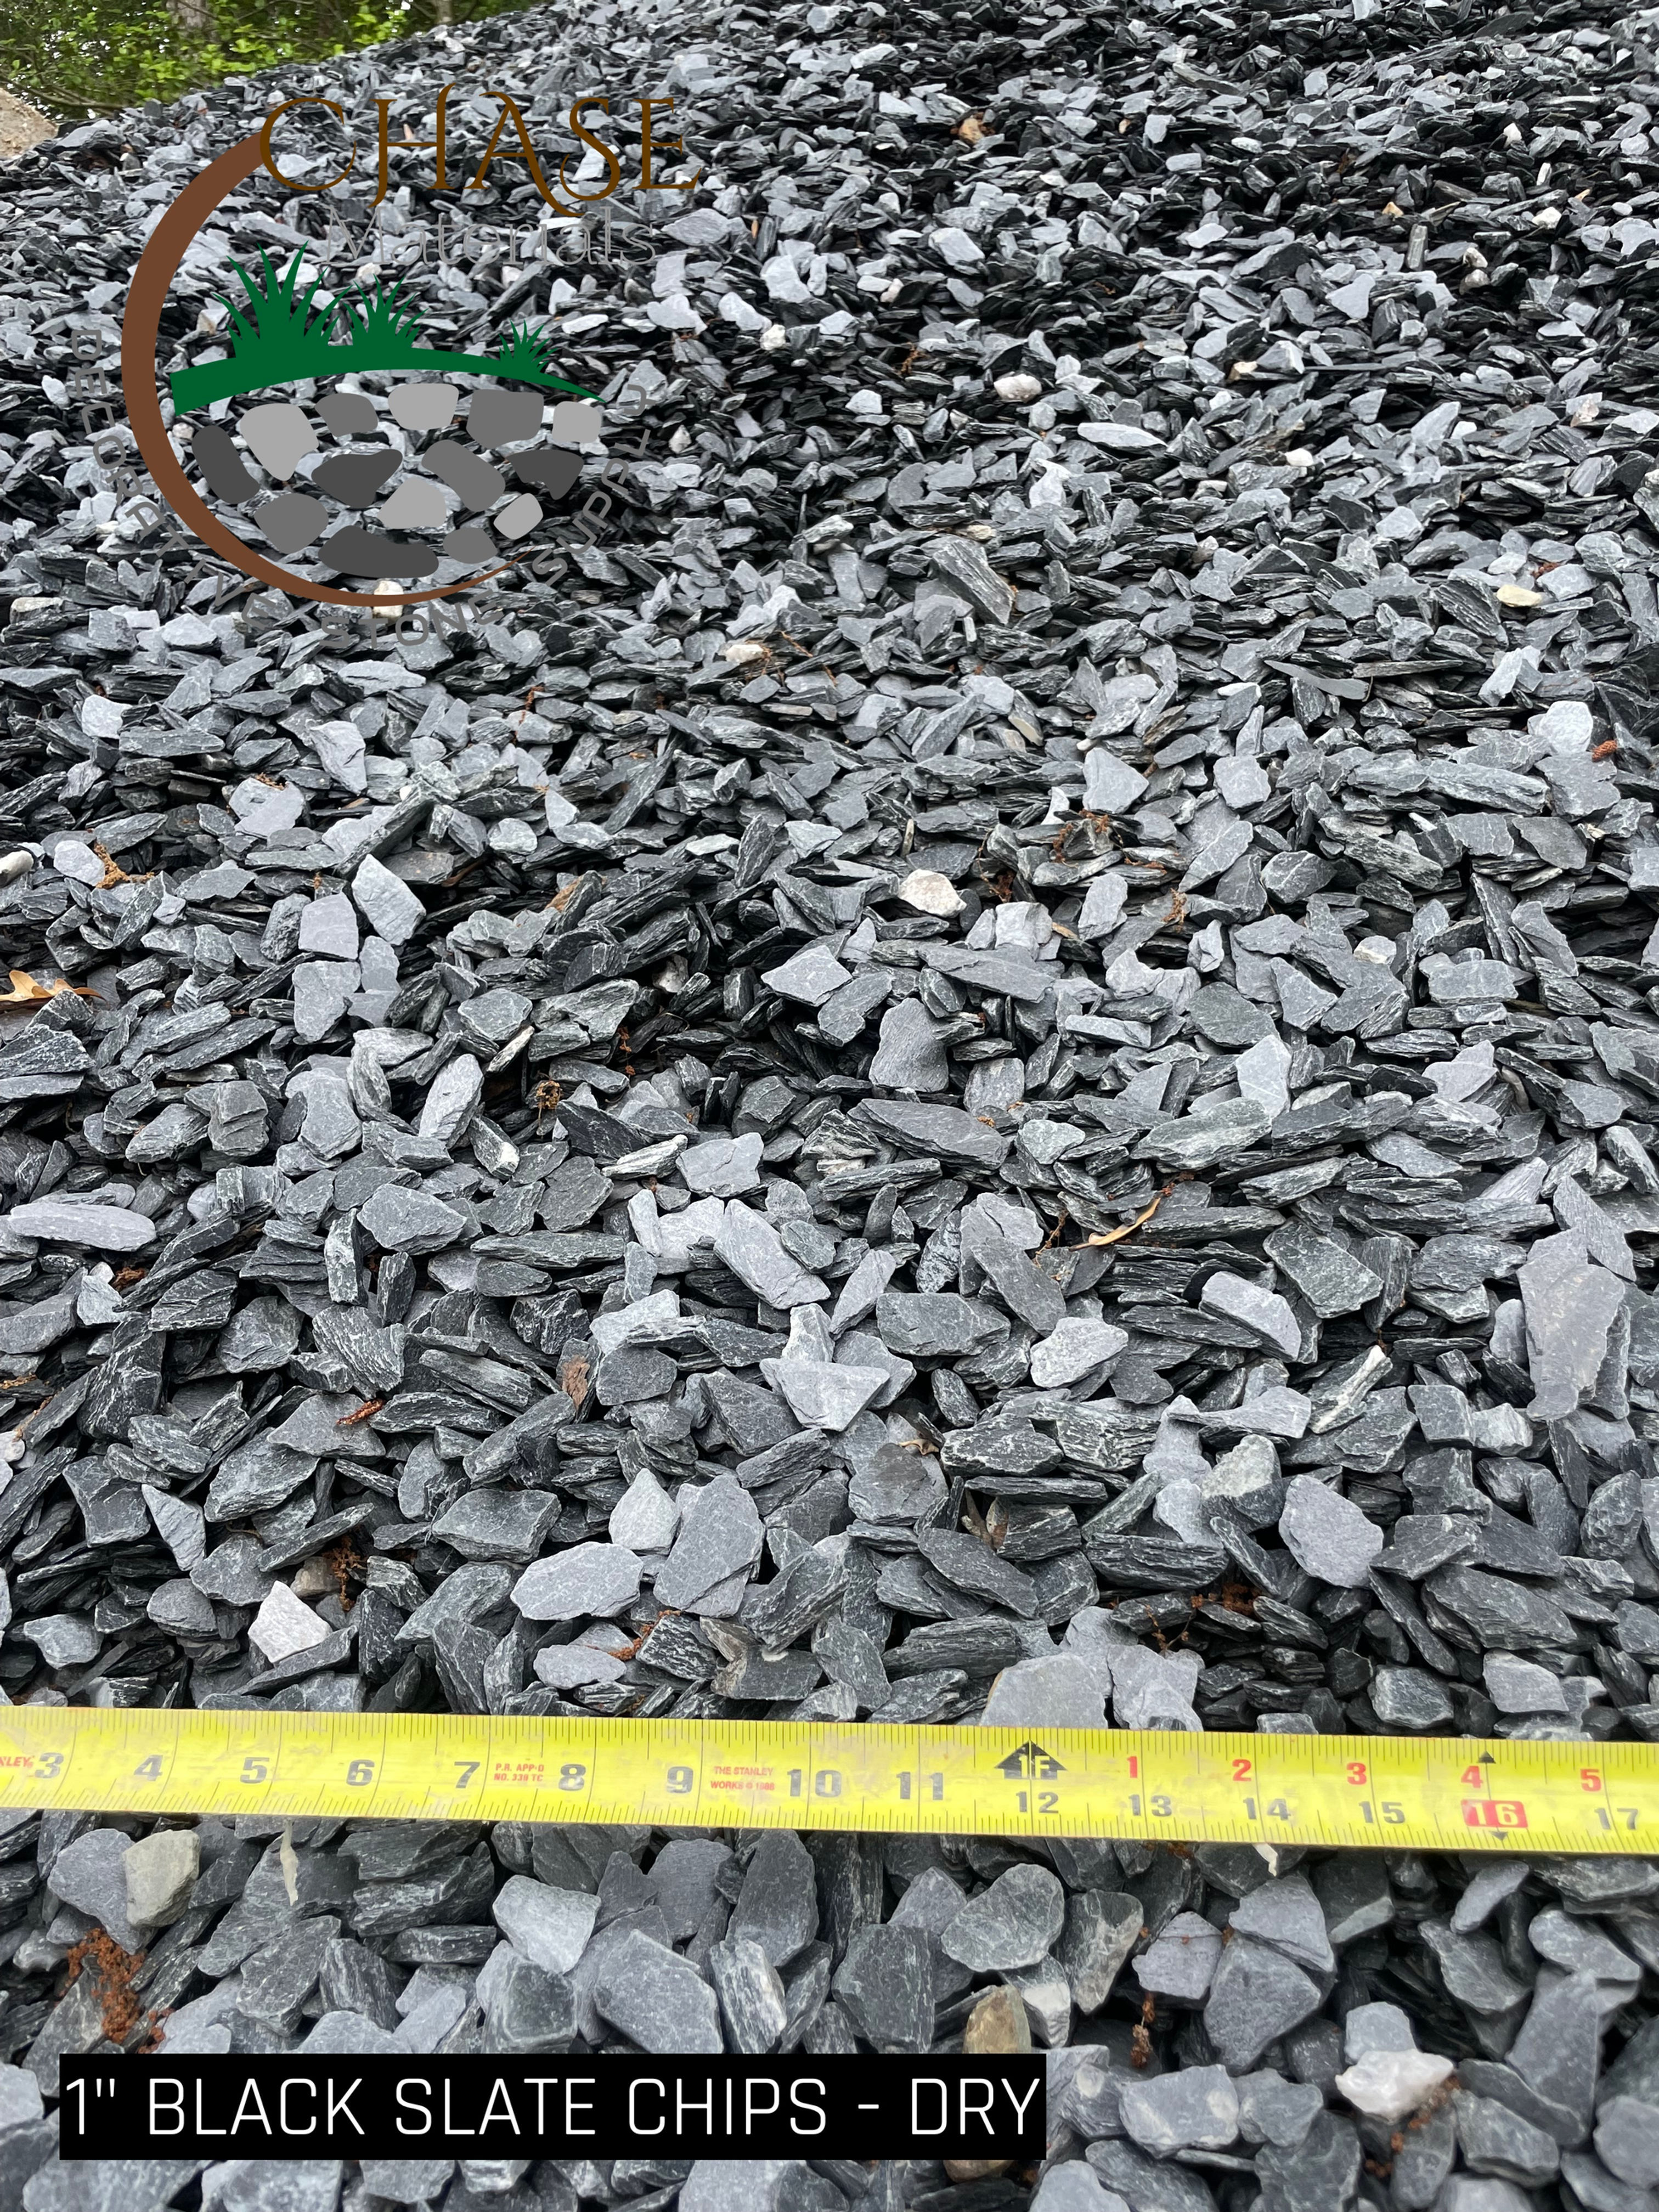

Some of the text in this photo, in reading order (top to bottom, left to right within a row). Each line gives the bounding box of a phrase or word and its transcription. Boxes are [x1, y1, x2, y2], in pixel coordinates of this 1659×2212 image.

[714, 1766, 774, 1776] THE STANLEY
[710, 1781, 743, 1790] WORKS
[35, 1752, 1639, 1830] 3 4 5 6 7 8 9 10 11 12 13 14 15 16 17
